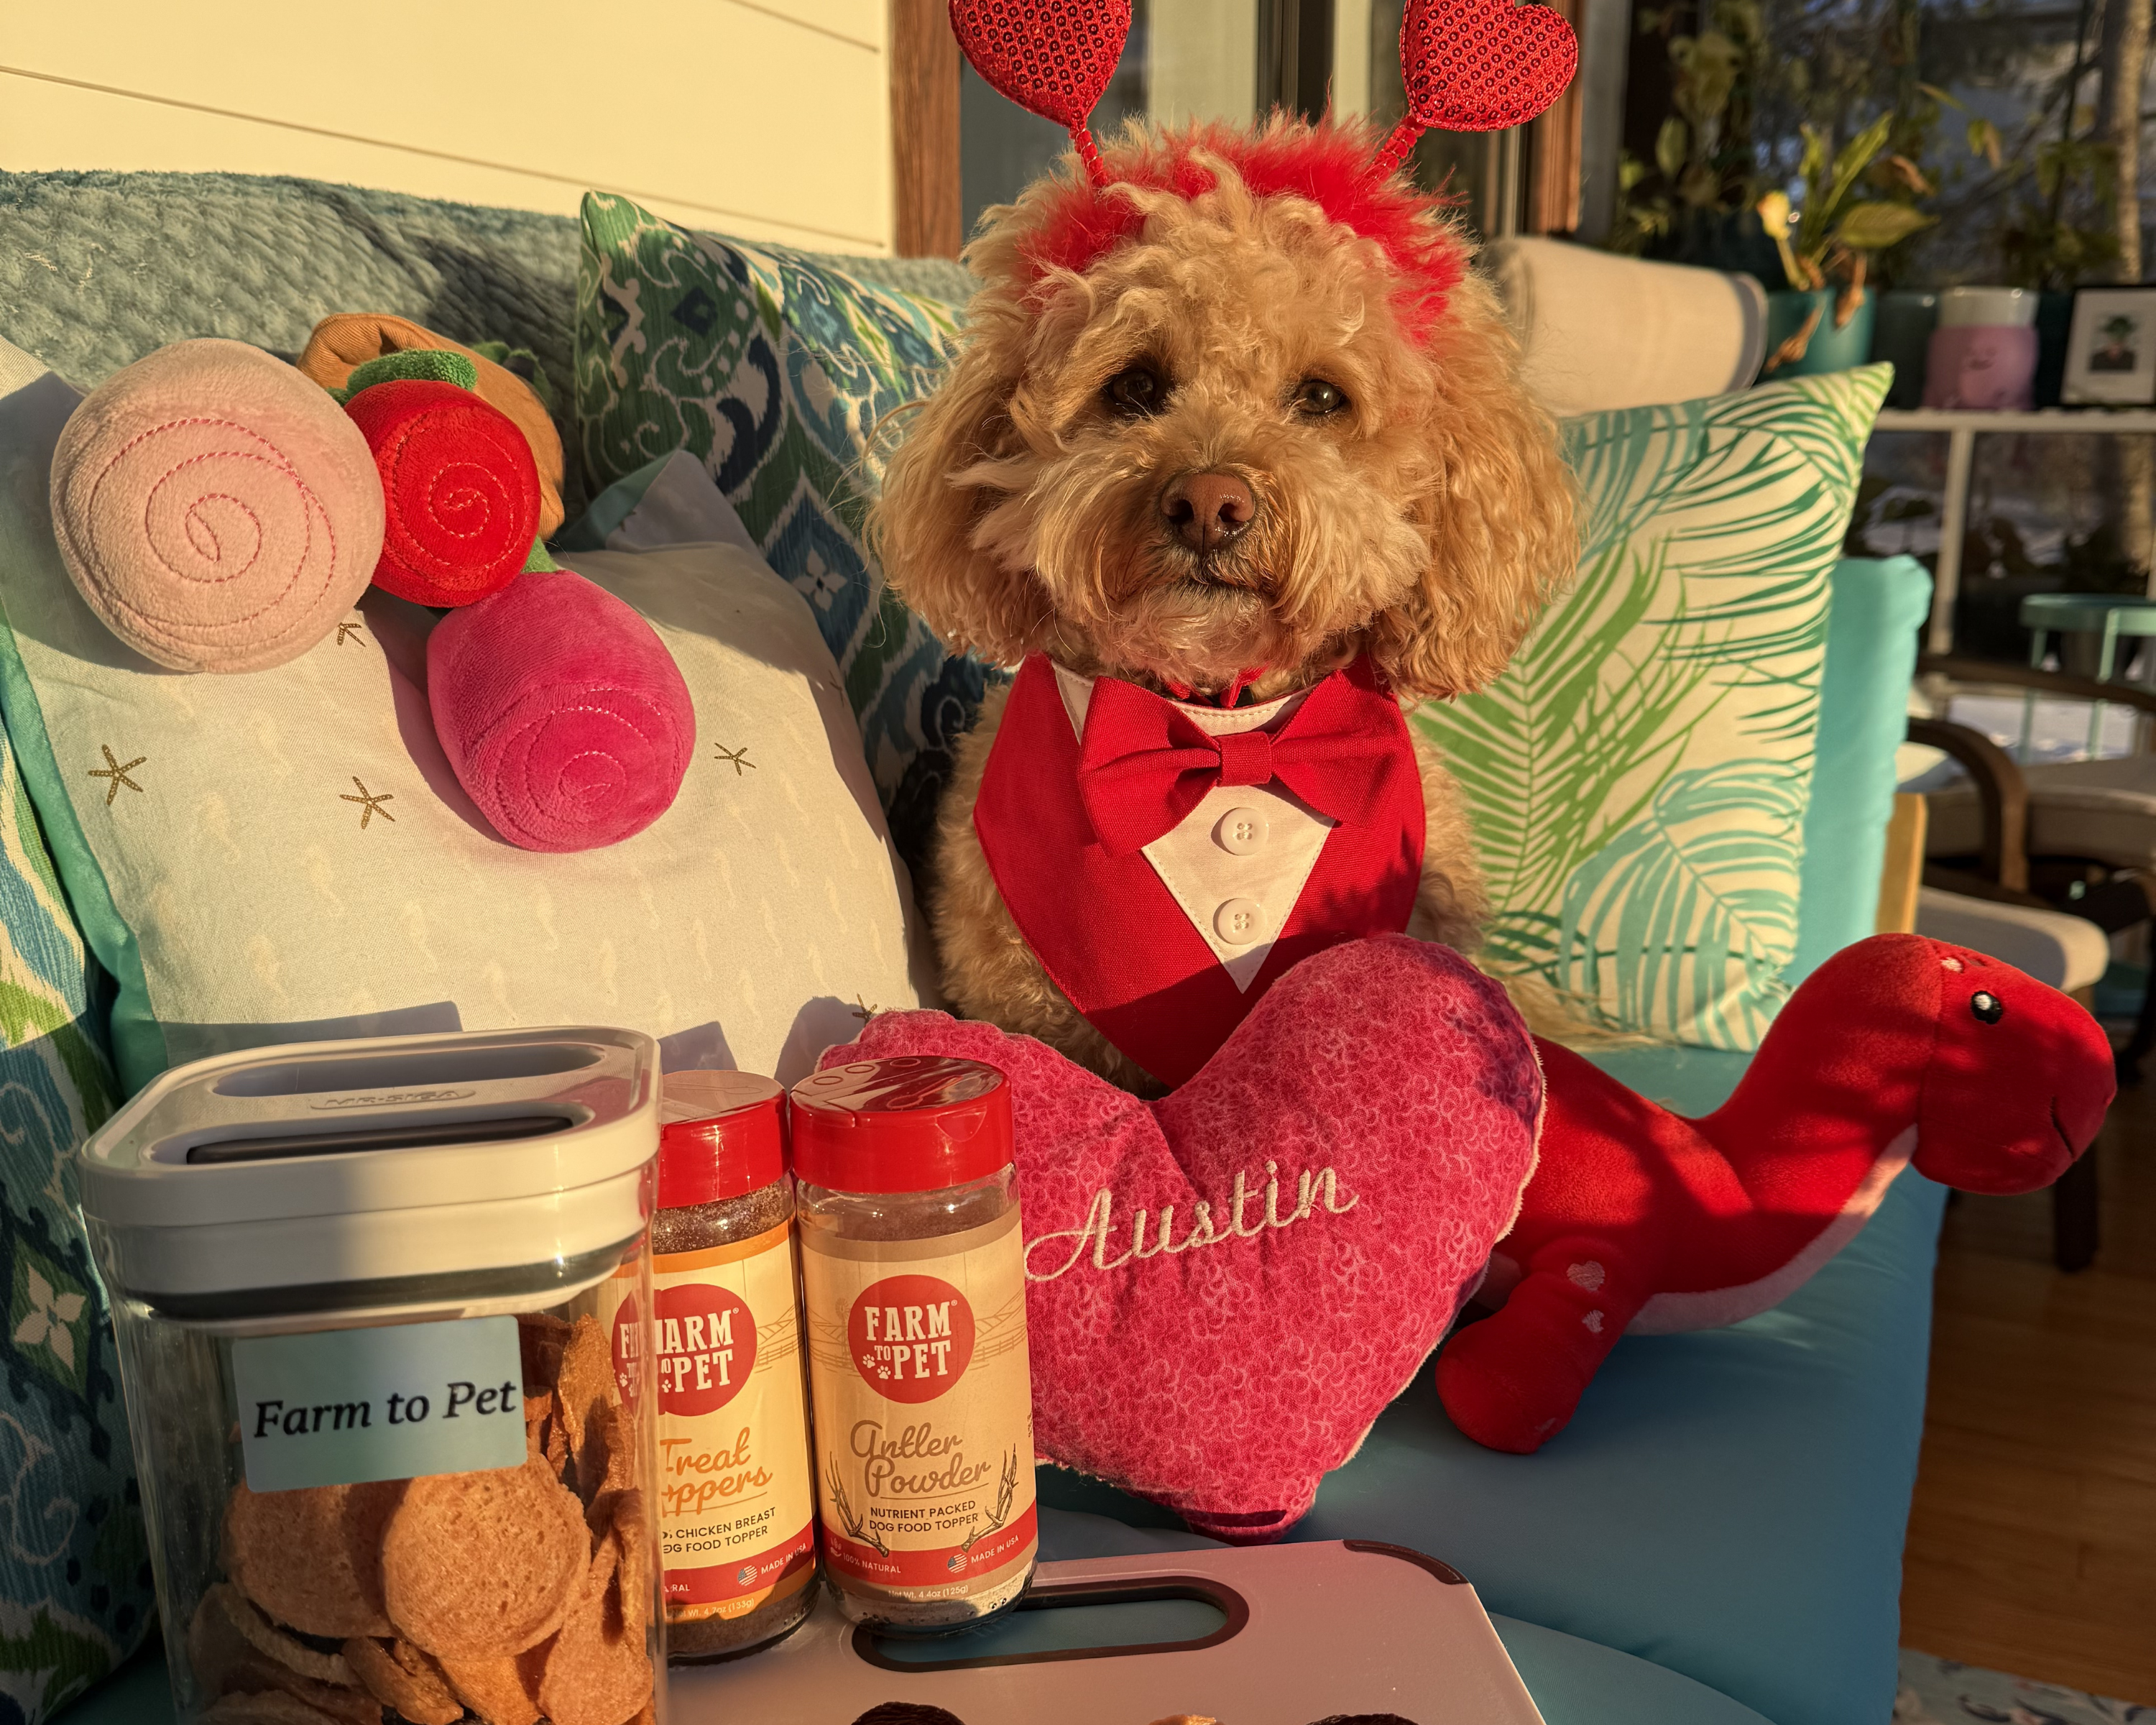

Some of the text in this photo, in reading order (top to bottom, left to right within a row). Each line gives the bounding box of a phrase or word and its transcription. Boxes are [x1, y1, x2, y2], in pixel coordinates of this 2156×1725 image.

[1023, 1160, 1360, 1282] Austin
[864, 1301, 952, 1342] FARM
[672, 1348, 734, 1393] PET
[874, 1340, 951, 1380] TO PET
[253, 1378, 517, 1439] Farm to Pet
[850, 1420, 963, 1458] Antler
[864, 1452, 992, 1497] Powder
[676, 1522, 732, 1539] CHICKEN
[735, 1506, 776, 1529] BREAST
[870, 1500, 976, 1519] NUTRIENT PACKED
[870, 1513, 978, 1532] DOG FOOD TOPPER
[686, 1540, 722, 1552] FOOD
[725, 1525, 768, 1546] TOPPER
[971, 1535, 1019, 1564] MADE IN USA
[760, 1542, 807, 1575] MADE IN USA
[843, 1552, 901, 1573] 100% NATURAL
[729, 1598, 755, 1613] (133g)
[918, 1590, 941, 1599] 4.4oz
[943, 1584, 969, 1598] (125g)
